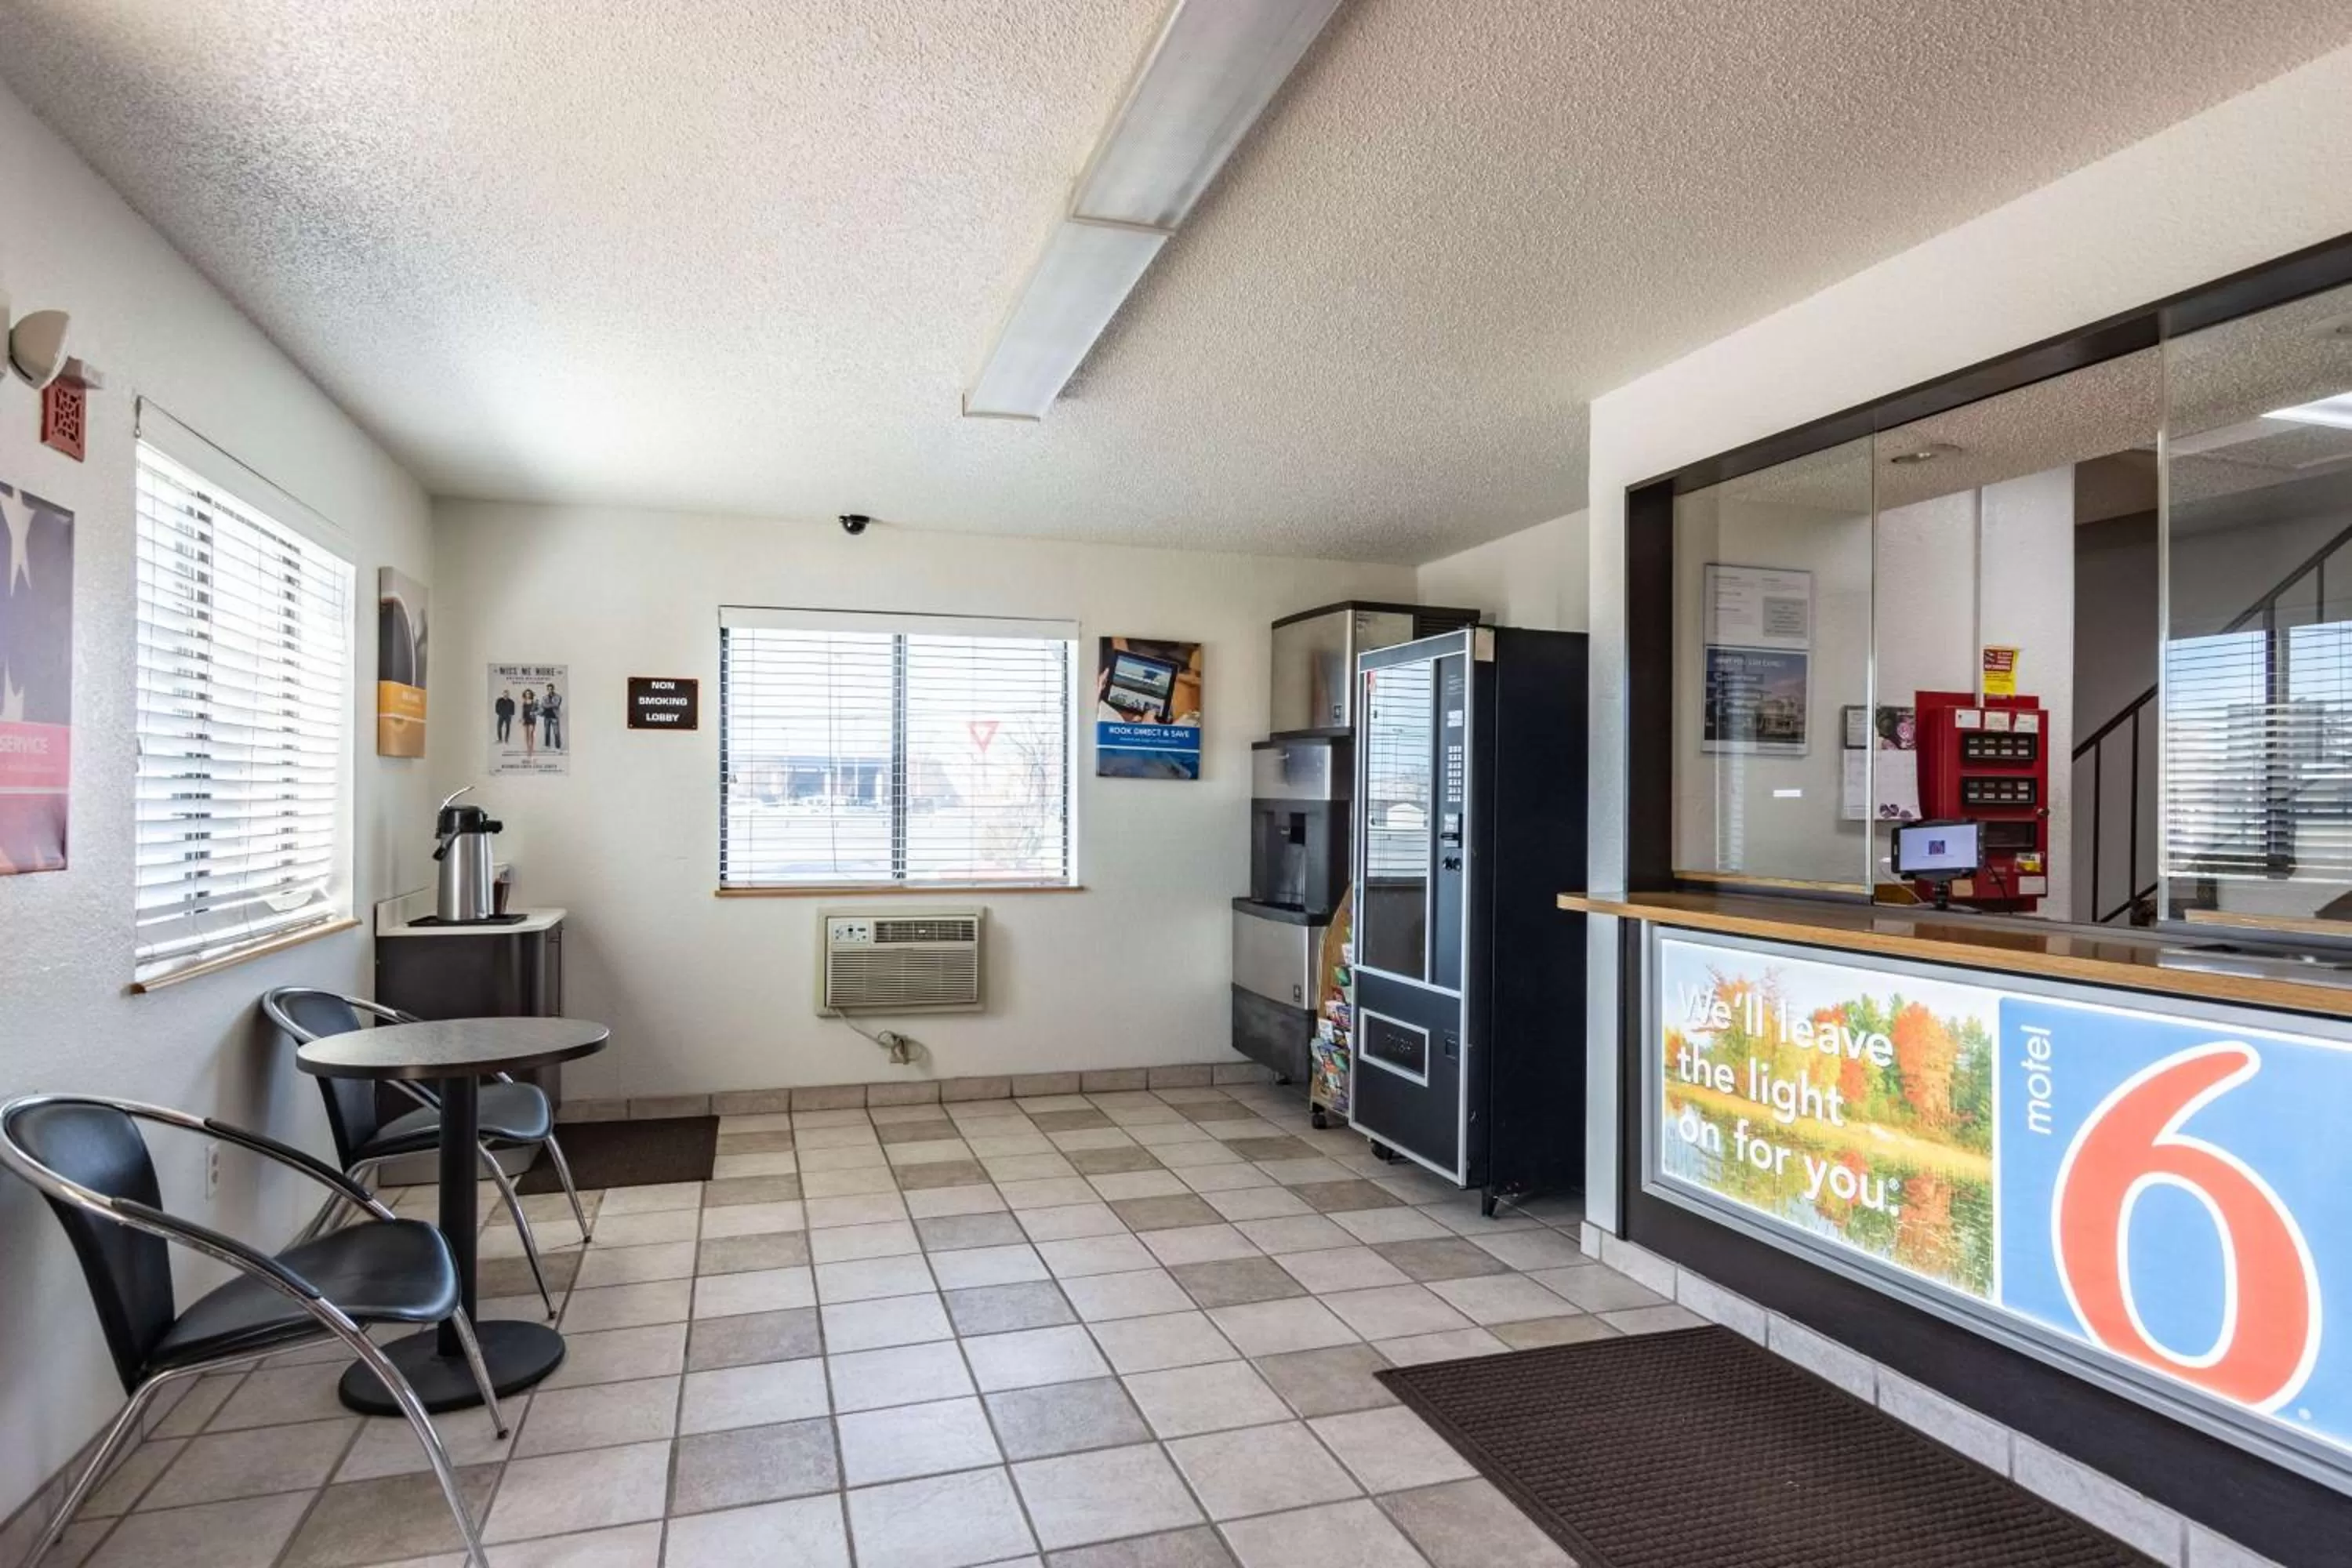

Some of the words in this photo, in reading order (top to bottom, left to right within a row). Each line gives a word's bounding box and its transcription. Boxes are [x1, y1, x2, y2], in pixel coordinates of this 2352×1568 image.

[651, 681, 675, 690] NON
[638, 695, 688, 706] SMOKING
[645, 713, 681, 722] LOBBY
[1134, 728, 1161, 736] DIRECT
[0, 735, 50, 753] SERVICE
[1678, 980, 1764, 1038] We'll
[1779, 1000, 1894, 1068] leave
[1676, 1041, 1736, 1094] the
[1748, 1056, 1846, 1127] light
[1678, 1112, 1719, 1152] on
[1733, 1118, 1792, 1175] for
[2020, 1024, 2053, 1136] motel
[2051, 1039, 2323, 1414] 6
